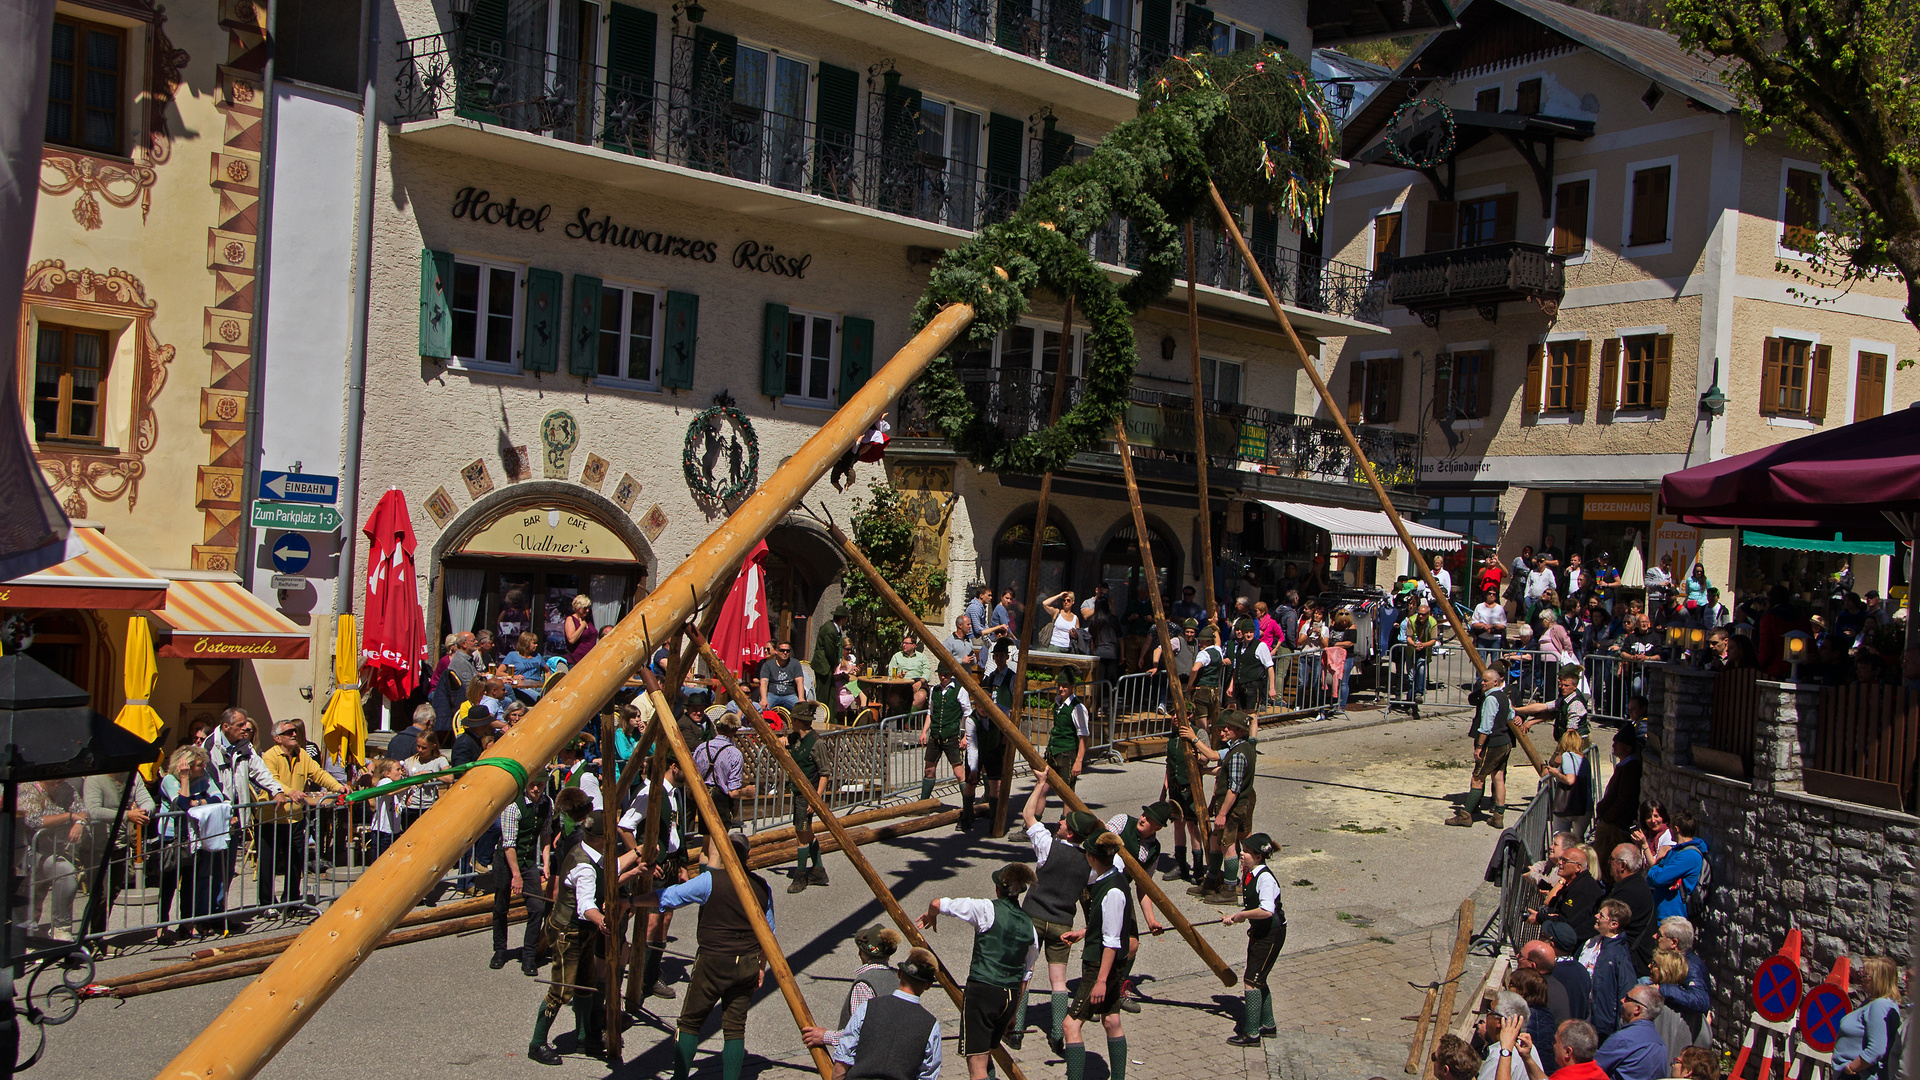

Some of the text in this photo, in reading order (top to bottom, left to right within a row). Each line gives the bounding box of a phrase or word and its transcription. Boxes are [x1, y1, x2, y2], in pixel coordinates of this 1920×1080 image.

[452, 187, 811, 279] Hotel Schwarzes Rössl
[1437, 461, 1491, 475] Schöndorfer
[285, 482, 326, 494] EINBAHN
[1584, 502, 1650, 512] KERZENHAUS
[255, 507, 333, 526] Zum Parkplatz 1-3
[523, 515, 541, 527] BAR
[567, 516, 588, 530] CAFE
[1658, 530, 1696, 540] KERZEN
[513, 533, 590, 554] Wallner's
[194, 637, 277, 654] Österreichs
